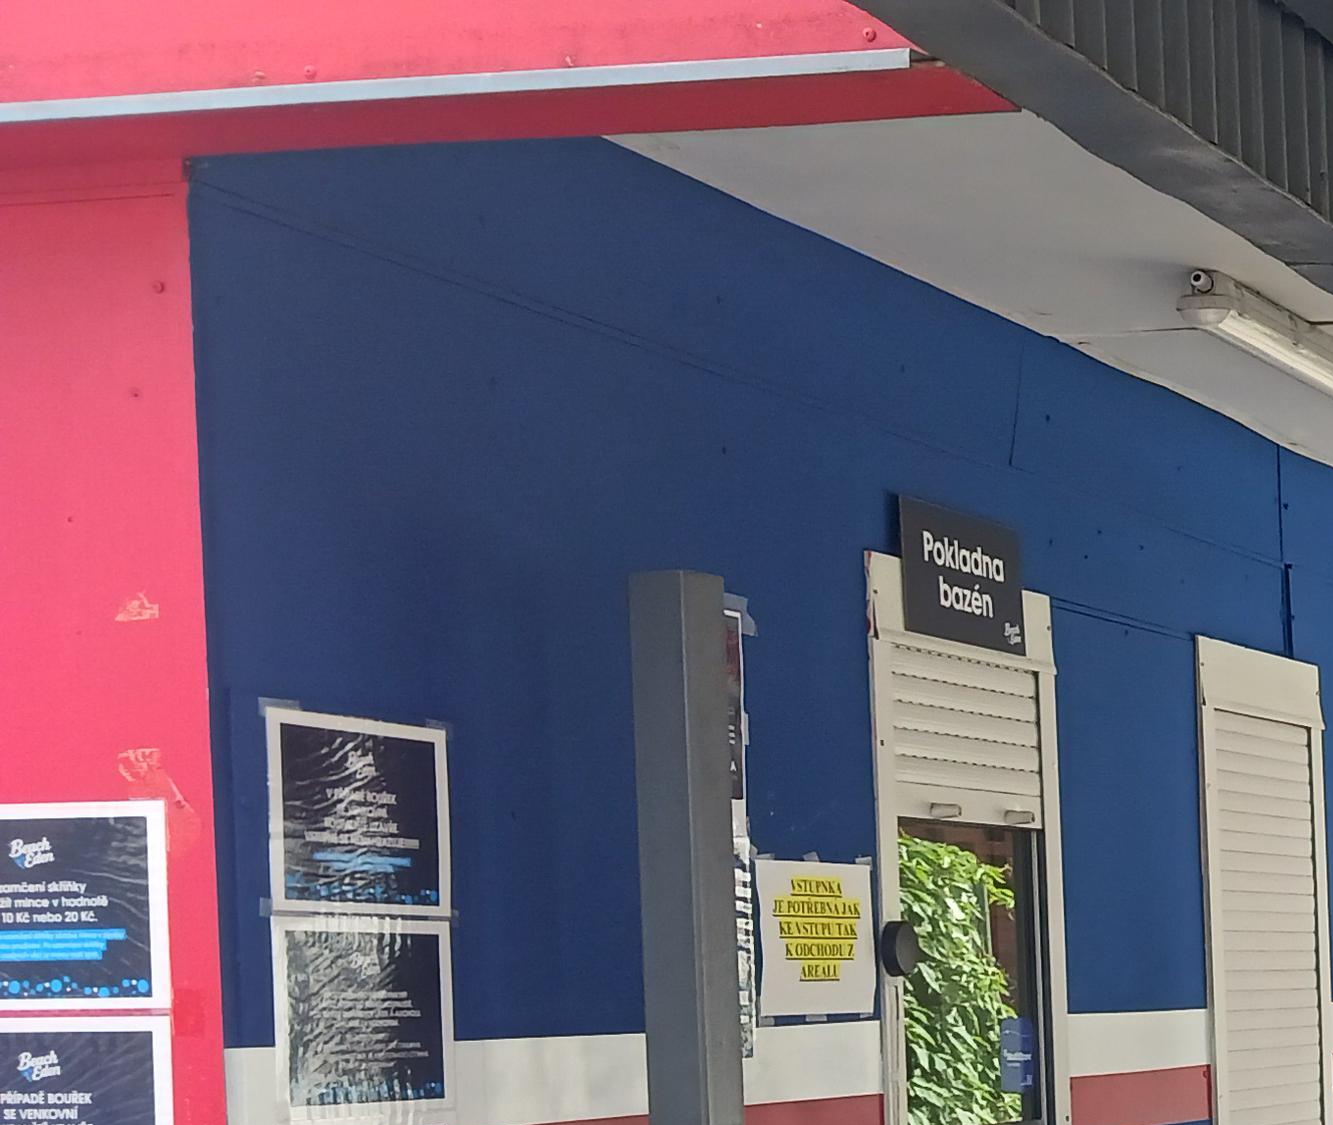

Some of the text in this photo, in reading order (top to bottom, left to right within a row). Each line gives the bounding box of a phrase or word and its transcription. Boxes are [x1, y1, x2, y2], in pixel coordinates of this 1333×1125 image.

[922, 530, 1005, 583] Pokladna
[938, 575, 994, 619] bazén
[8, 836, 52, 858] Beach
[24, 851, 55, 869] Eden
[0, 881, 46, 893] amčení
[14, 897, 50, 908] mince
[51, 899, 60, 908] v
[61, 895, 109, 908] hodnotě
[772, 899, 784, 913] JE
[841, 902, 861, 916] JAK
[1, 910, 98, 923] 10 Kč nebo 20 Kč.
[779, 921, 858, 937] KE VSTUPU TAK
[785, 943, 793, 956] K
[795, 943, 846, 957] ODCHODU
[17, 1049, 59, 1071] Beach
[47, 1090, 93, 1104] BOUŘEK
[3, 1105, 79, 1120] SE VENKOVNÍ
